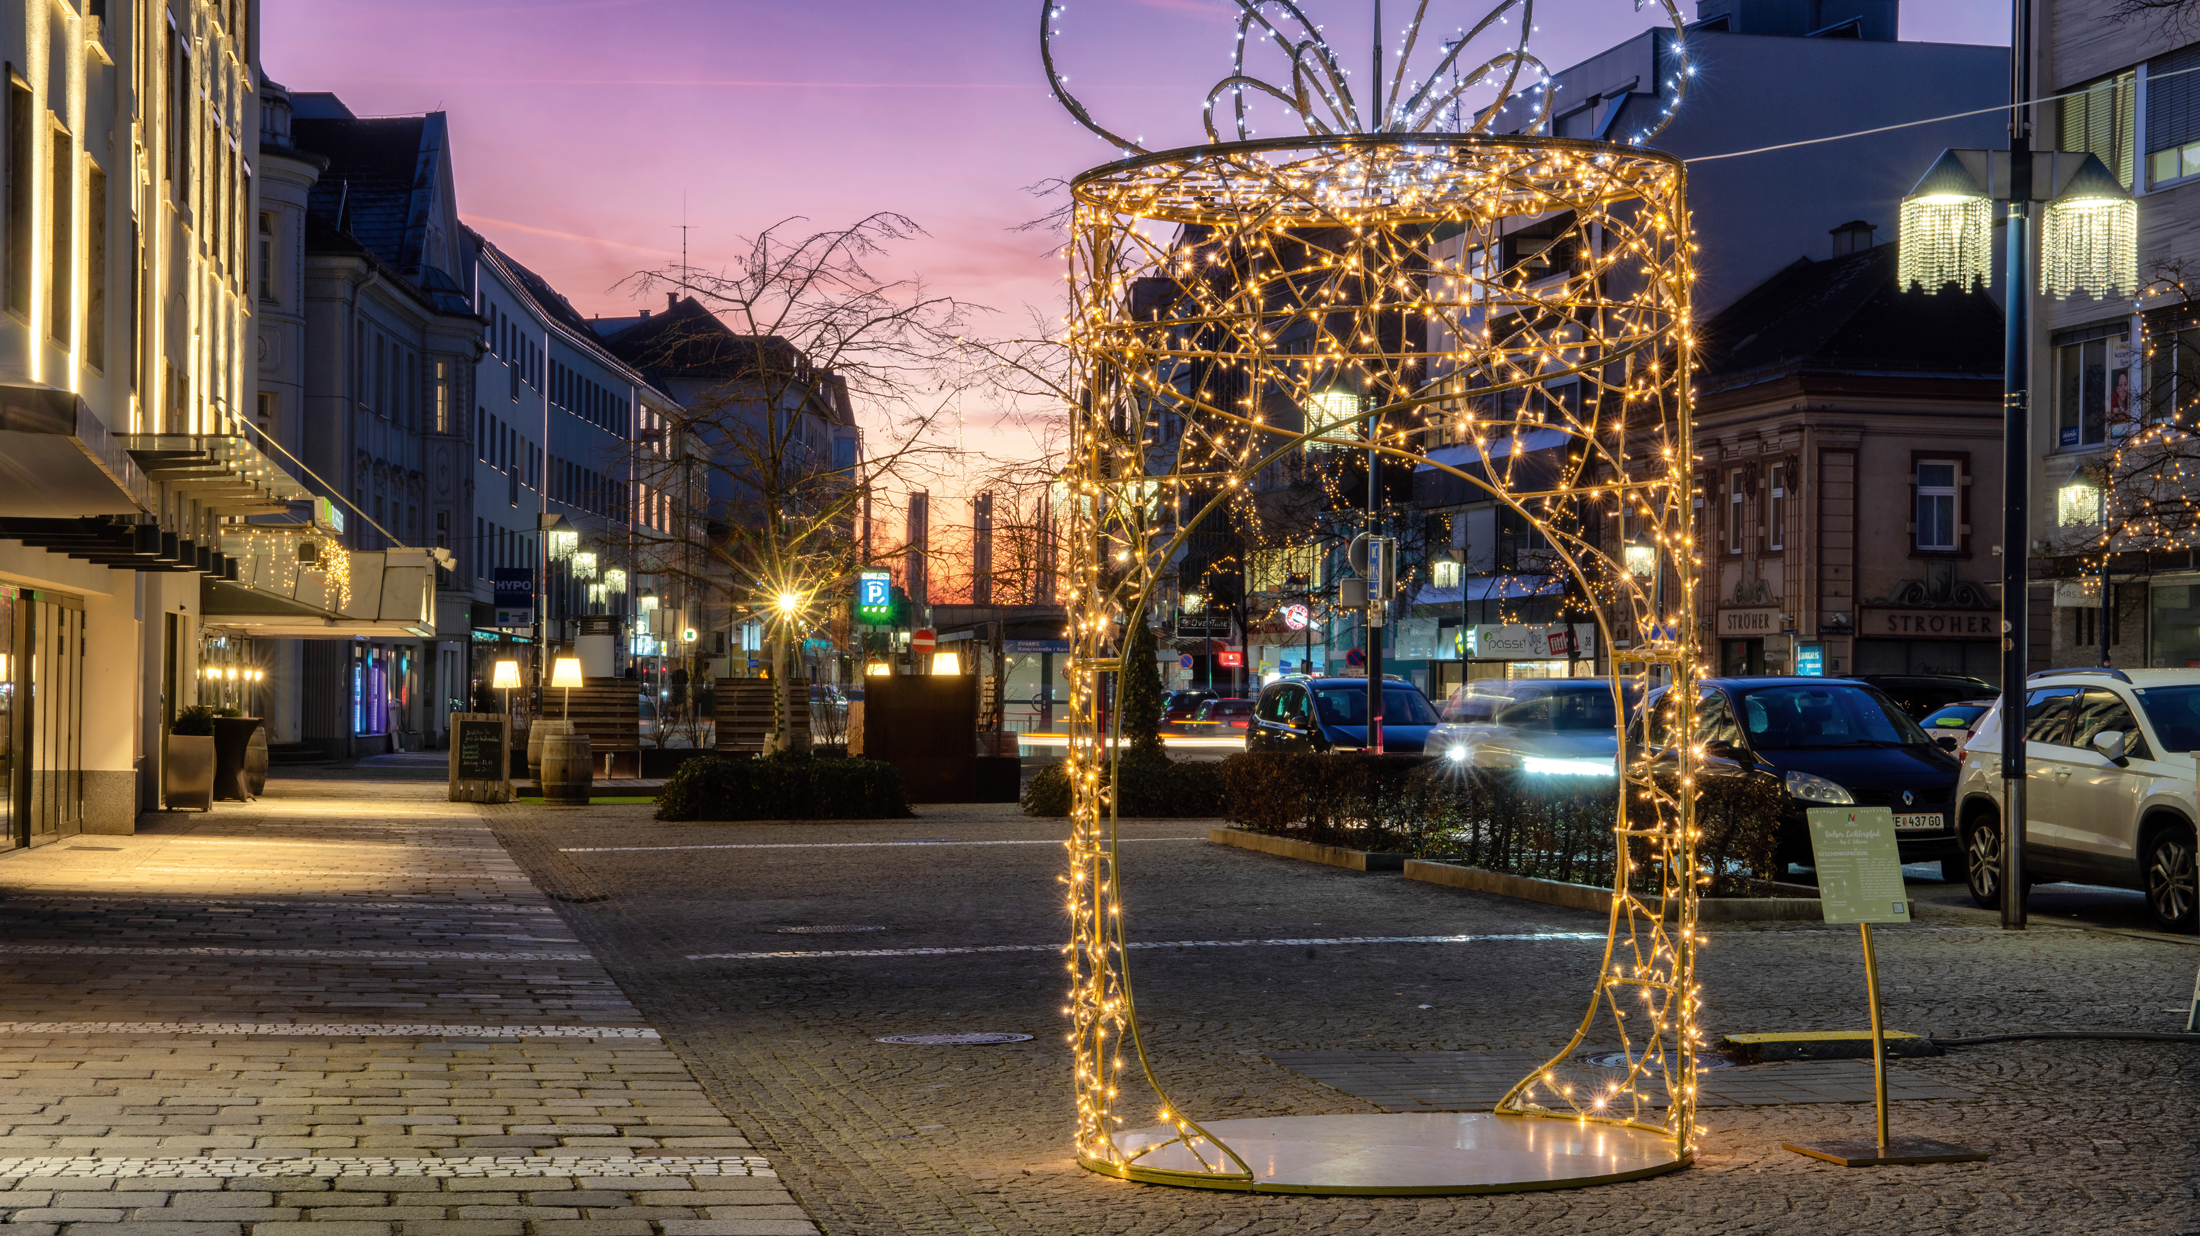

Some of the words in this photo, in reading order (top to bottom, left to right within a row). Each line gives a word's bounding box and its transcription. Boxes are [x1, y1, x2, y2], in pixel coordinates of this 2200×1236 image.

[496, 580, 532, 590] HYPO
[868, 585, 882, 603] P
[1727, 613, 1770, 630] STRÖHER
[1888, 614, 1993, 633] STRÖHER
[1529, 631, 1542, 647] Joya
[1892, 816, 1901, 827] E
[1909, 816, 1927, 827] 437
[1928, 816, 1941, 827] GO
[1846, 829, 1881, 839] Lichterpfad
